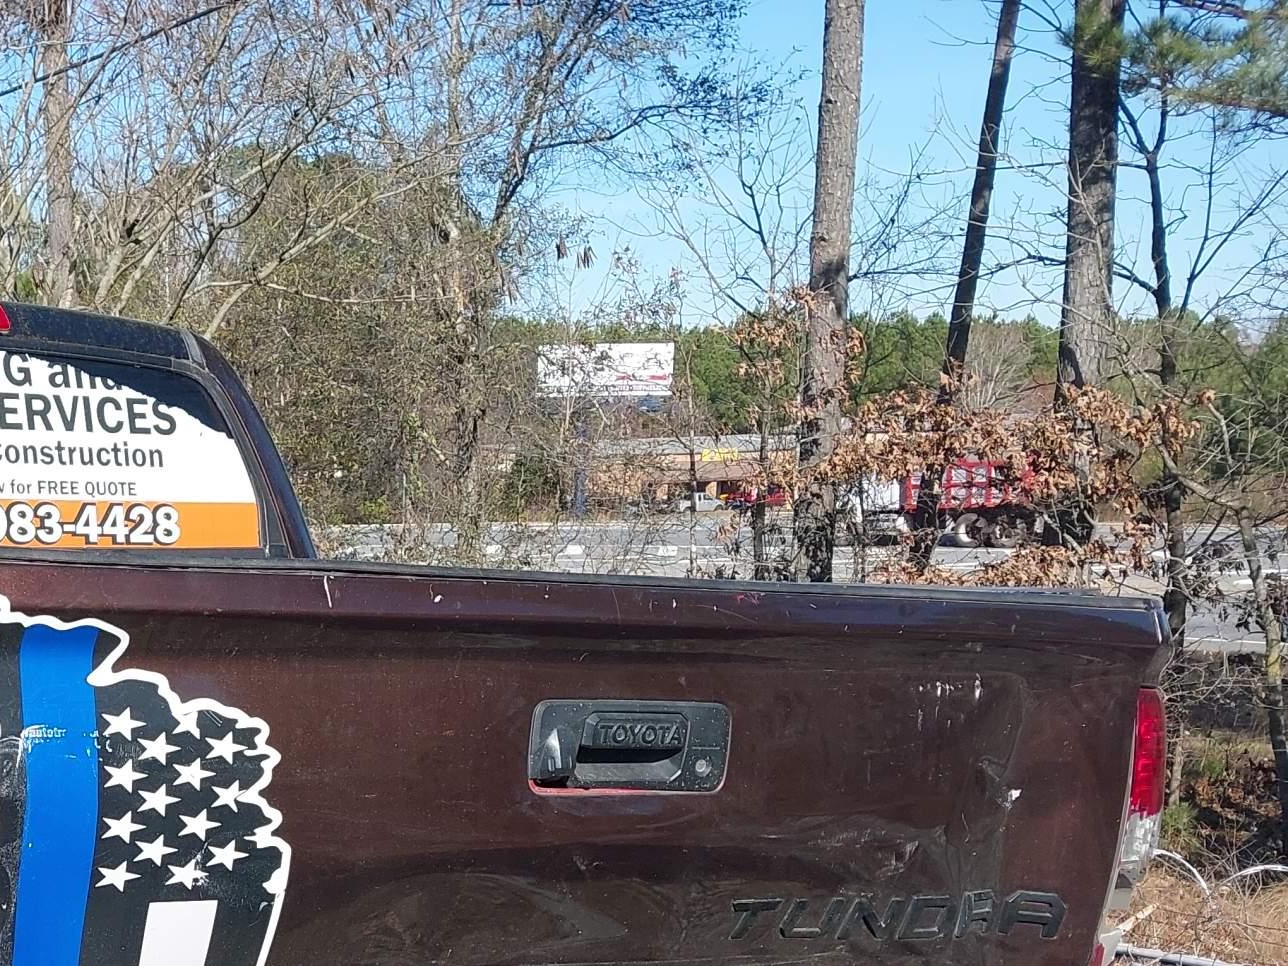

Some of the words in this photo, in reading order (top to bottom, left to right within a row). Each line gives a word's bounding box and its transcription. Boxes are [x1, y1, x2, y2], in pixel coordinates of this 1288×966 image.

[11, 479, 32, 494] for
[37, 480, 80, 495] FREE
[84, 481, 137, 497] QUOTE
[598, 721, 683, 744] TOYOTA
[728, 889, 1068, 940] TUNDRA
